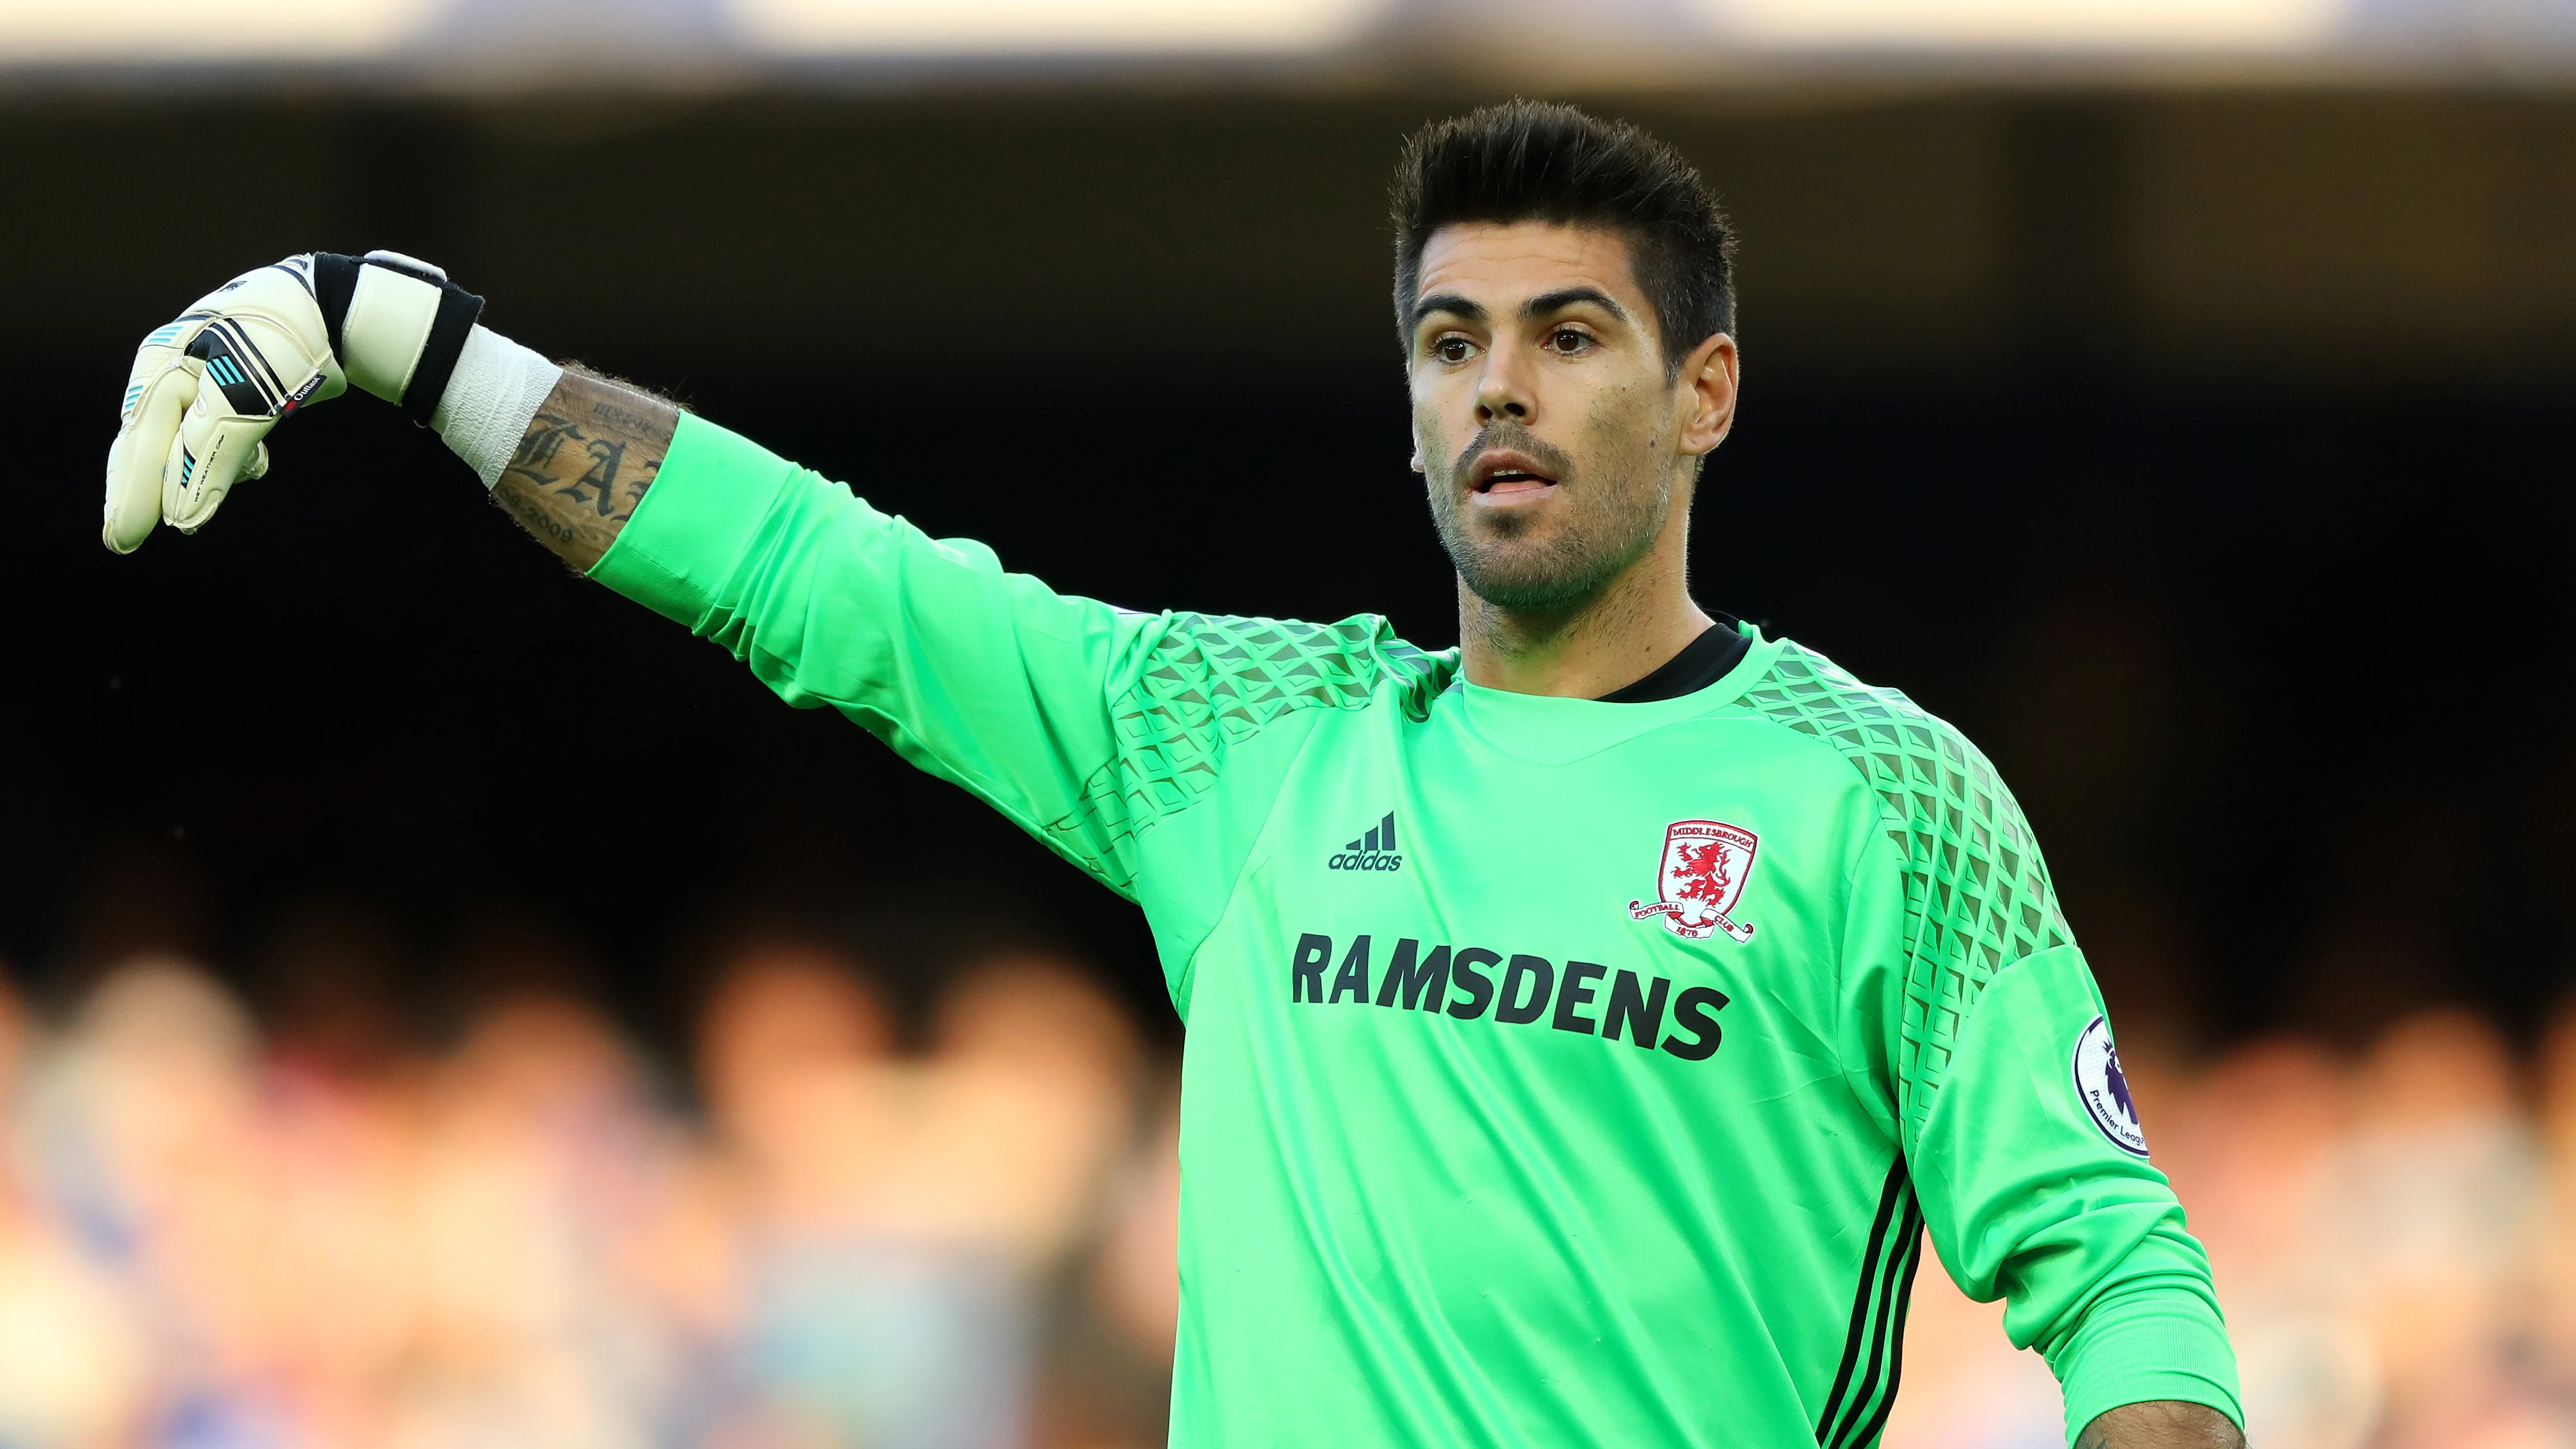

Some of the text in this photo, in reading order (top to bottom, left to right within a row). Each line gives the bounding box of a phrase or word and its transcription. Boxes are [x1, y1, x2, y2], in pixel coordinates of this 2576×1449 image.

[294, 378, 320, 401] Outlast
[200, 451, 216, 485] WEATHER
[1672, 827, 1754, 848] MIDDLESBROUGH
[1328, 850, 1402, 871] adidas
[1634, 903, 1680, 918] FOOTBALL
[1676, 926, 1698, 937] 1876
[1714, 915, 1734, 932] CLUB
[1292, 933, 1730, 1061] RAMSDENS
[2090, 1090, 2119, 1130] Premier
